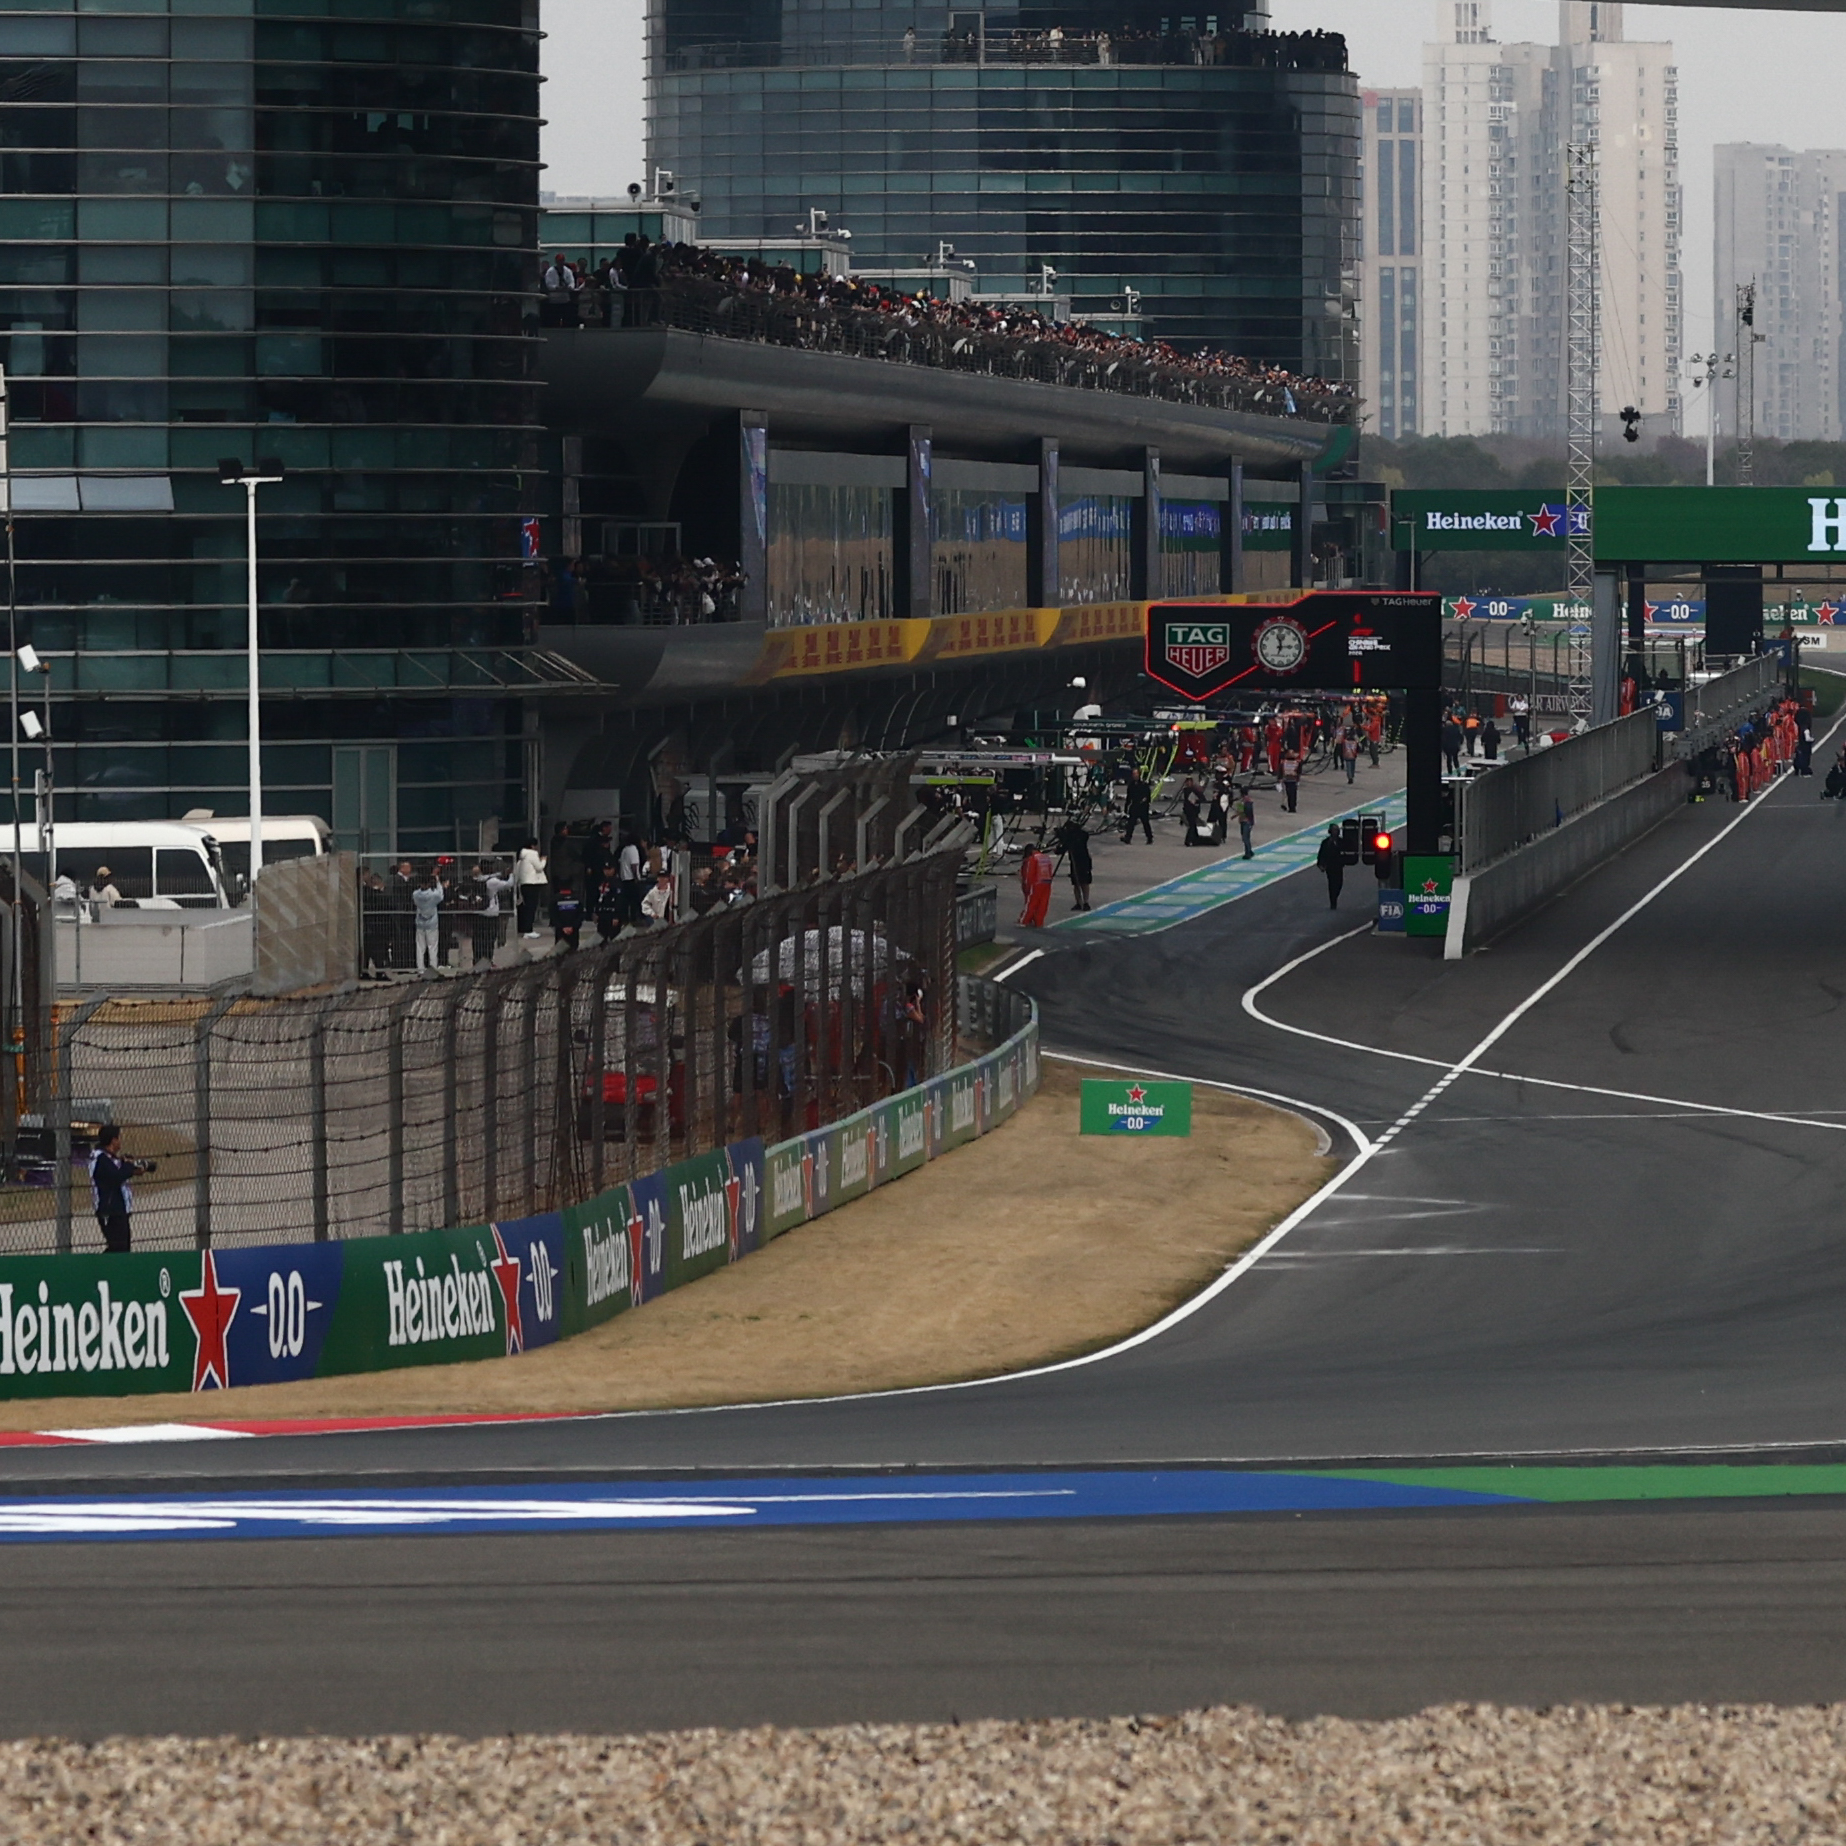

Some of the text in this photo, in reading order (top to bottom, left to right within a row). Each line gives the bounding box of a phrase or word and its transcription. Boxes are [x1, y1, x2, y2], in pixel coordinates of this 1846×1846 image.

[1171, 628, 1224, 643] TAG
[1170, 648, 1226, 675] HEUER
[1380, 904, 1402, 917] FIA
[269, 1271, 304, 1358] 0.0
